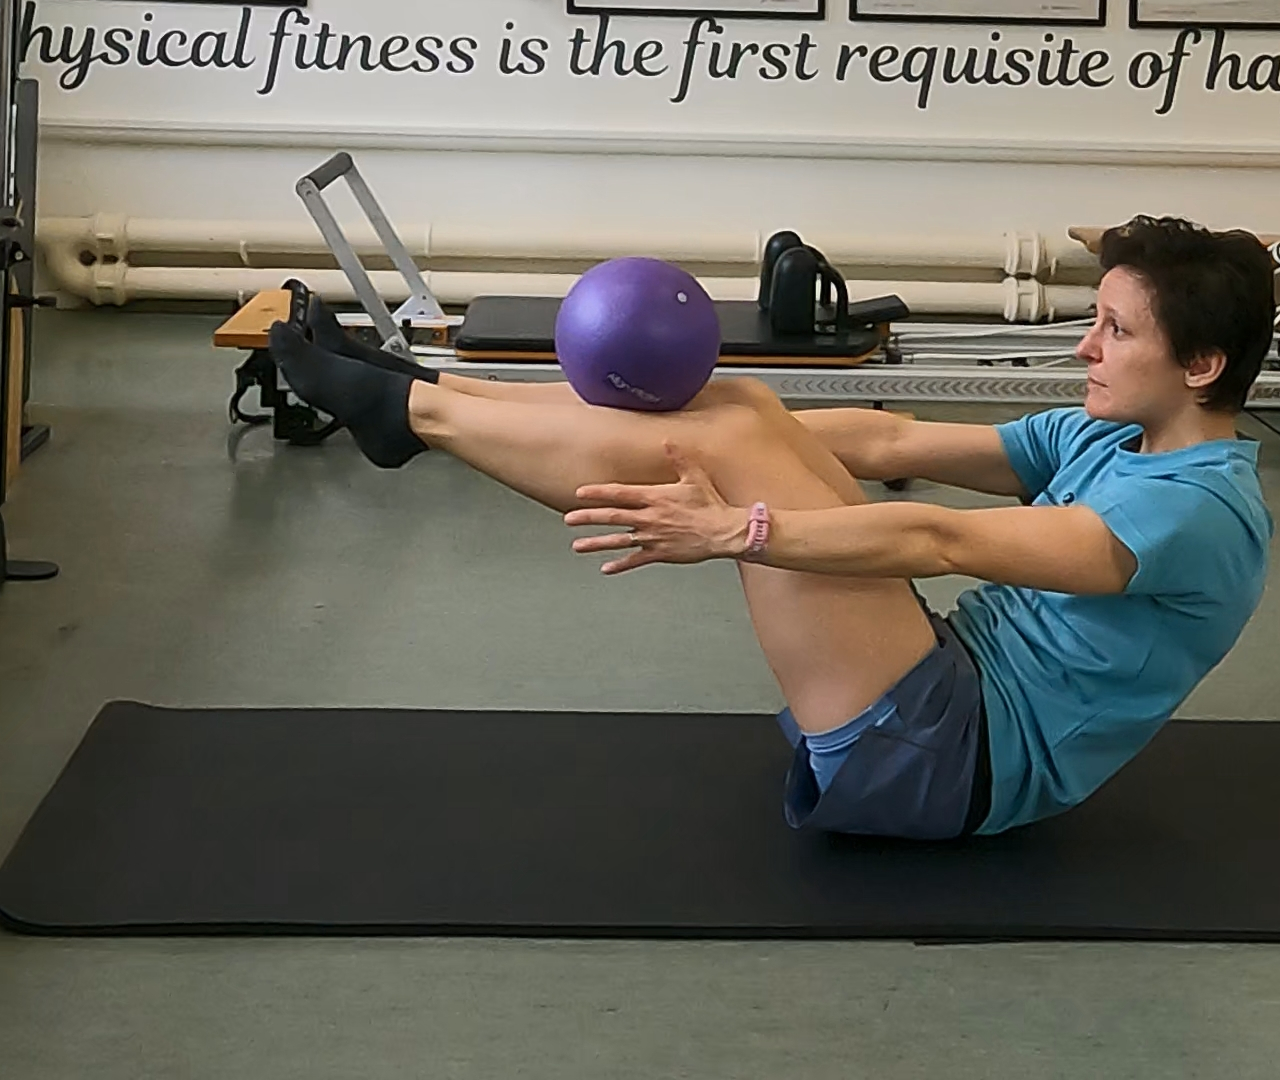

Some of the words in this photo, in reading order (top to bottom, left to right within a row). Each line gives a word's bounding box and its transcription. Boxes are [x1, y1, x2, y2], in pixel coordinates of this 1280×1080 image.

[257, 7, 478, 95] fitness
[499, 21, 549, 75] is
[568, 14, 669, 77] the
[669, 16, 819, 103] first
[835, 31, 1114, 109] requisite
[1128, 27, 1202, 115] of
